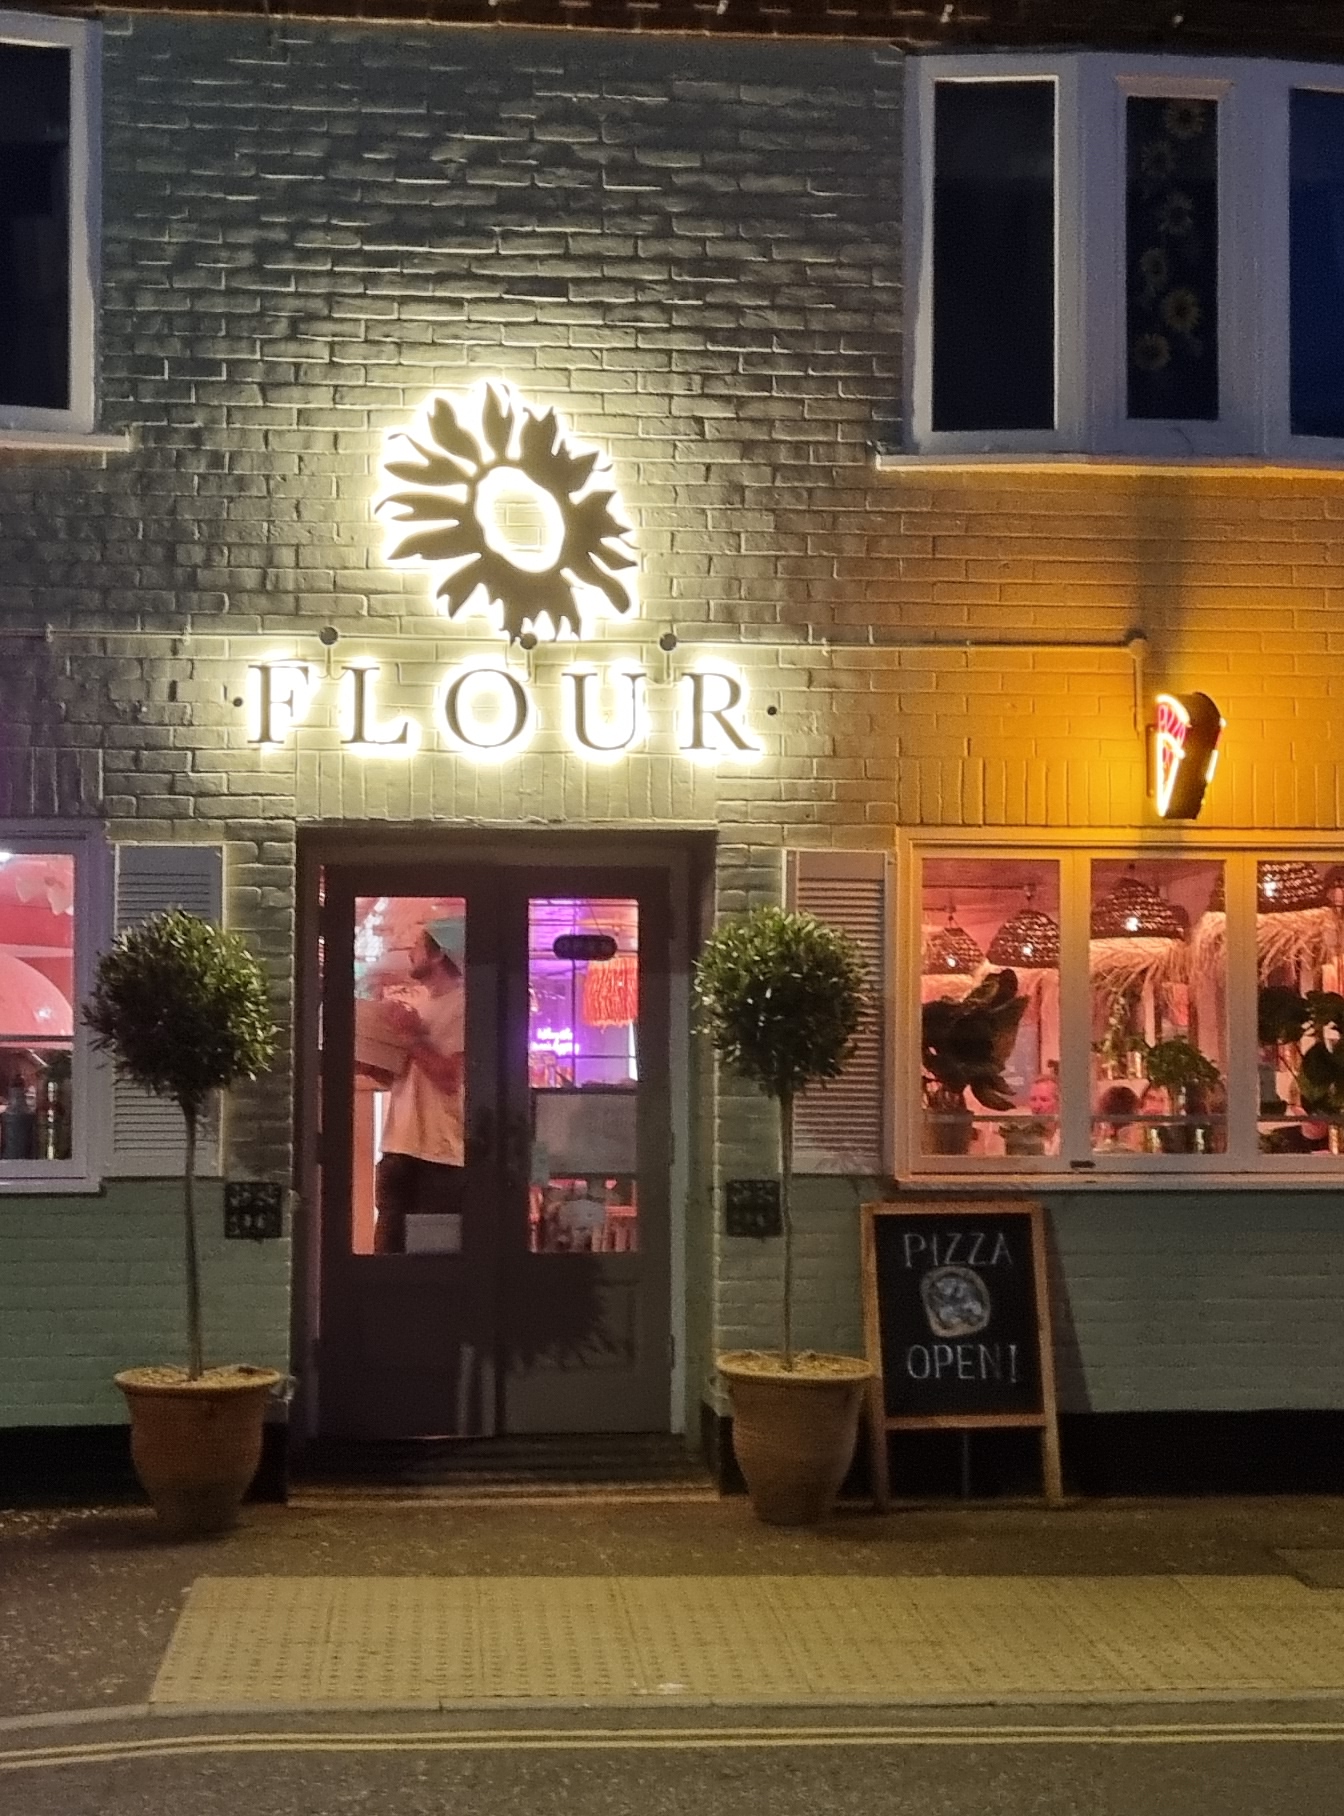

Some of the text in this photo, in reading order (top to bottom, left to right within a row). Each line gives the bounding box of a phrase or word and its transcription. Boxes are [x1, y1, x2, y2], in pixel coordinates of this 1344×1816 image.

[247, 664, 761, 752] FLOUR
[903, 1232, 1014, 1269] PIZZA
[907, 1344, 1018, 1384] OPEN!
